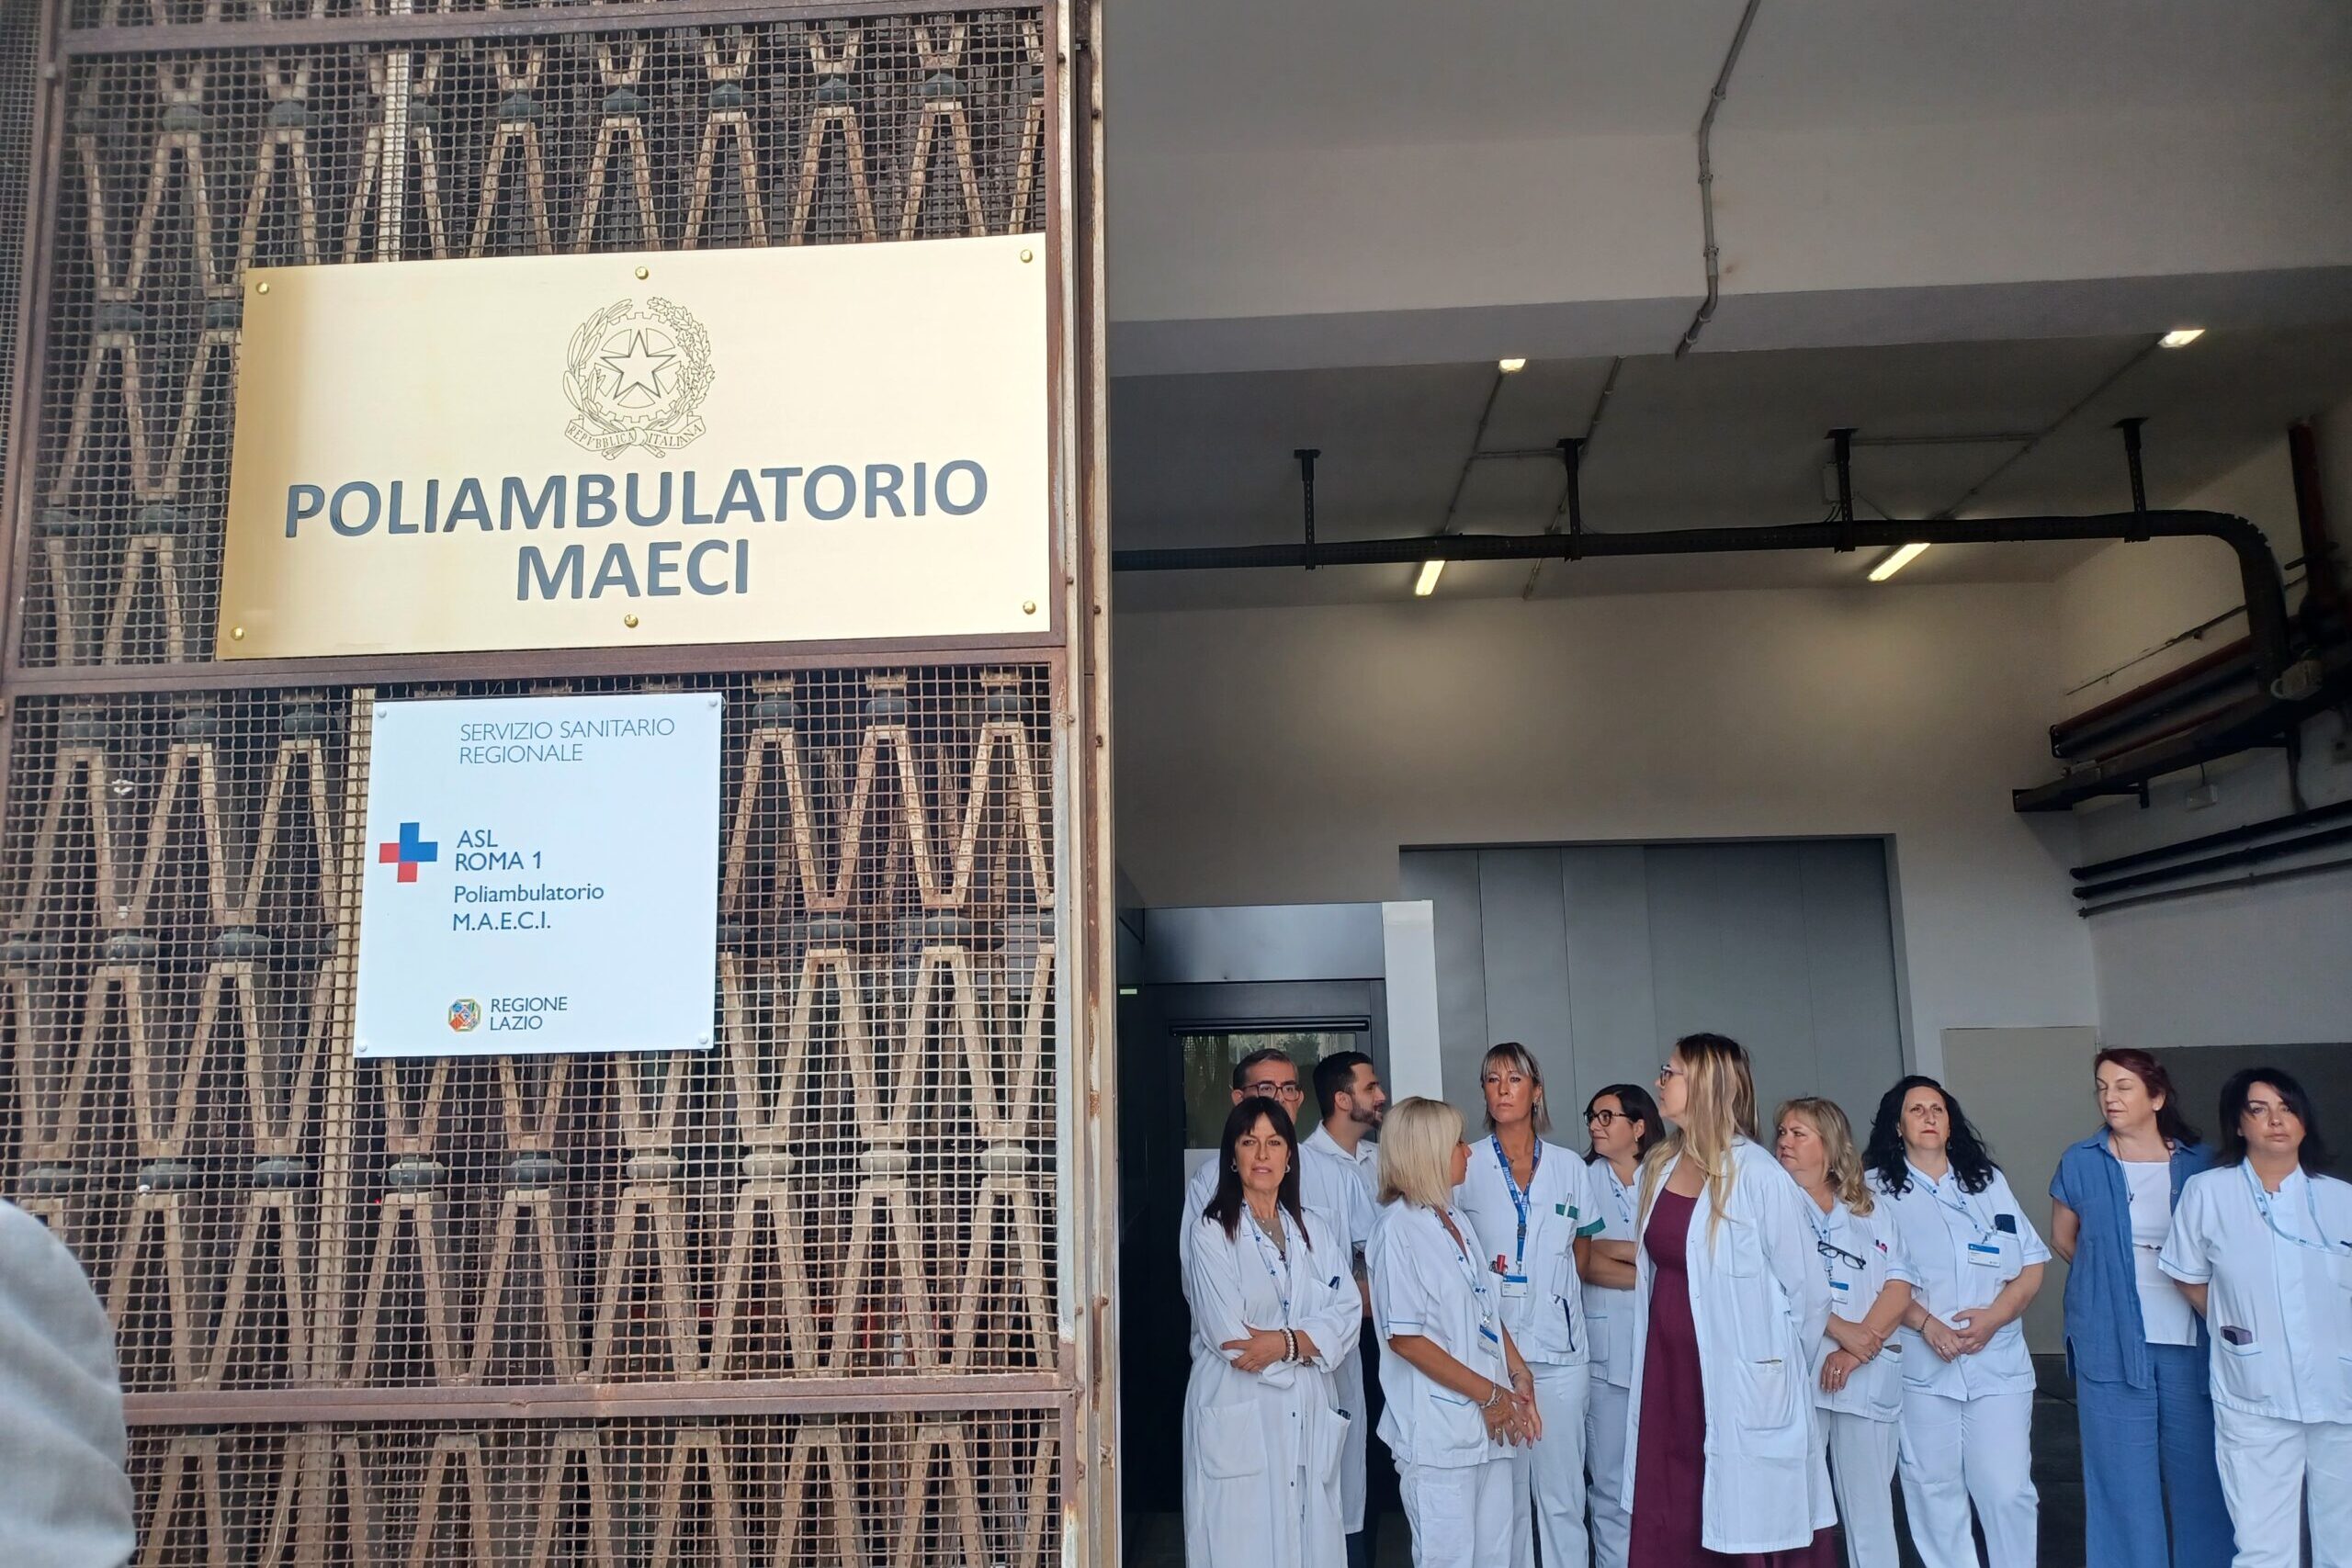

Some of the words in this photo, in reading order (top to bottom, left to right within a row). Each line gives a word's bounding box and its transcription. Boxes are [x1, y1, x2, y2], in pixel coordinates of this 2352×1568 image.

[648, 423, 703, 447] ITALIANA
[283, 460, 989, 539] POLIAMBULATORIO
[517, 539, 750, 602] MAECI
[460, 721, 553, 742] SERVIZIO
[560, 717, 675, 739] SANITARIO
[459, 743, 583, 764] REGIONALE
[457, 829, 499, 849] ASL
[455, 851, 525, 872] ROMA
[532, 851, 542, 870] 1
[454, 883, 605, 904] Poliambulatorio
[453, 910, 551, 931] M.A.E.C.I.
[490, 996, 568, 1013] REGIONE
[489, 1015, 544, 1032] LAZIO
